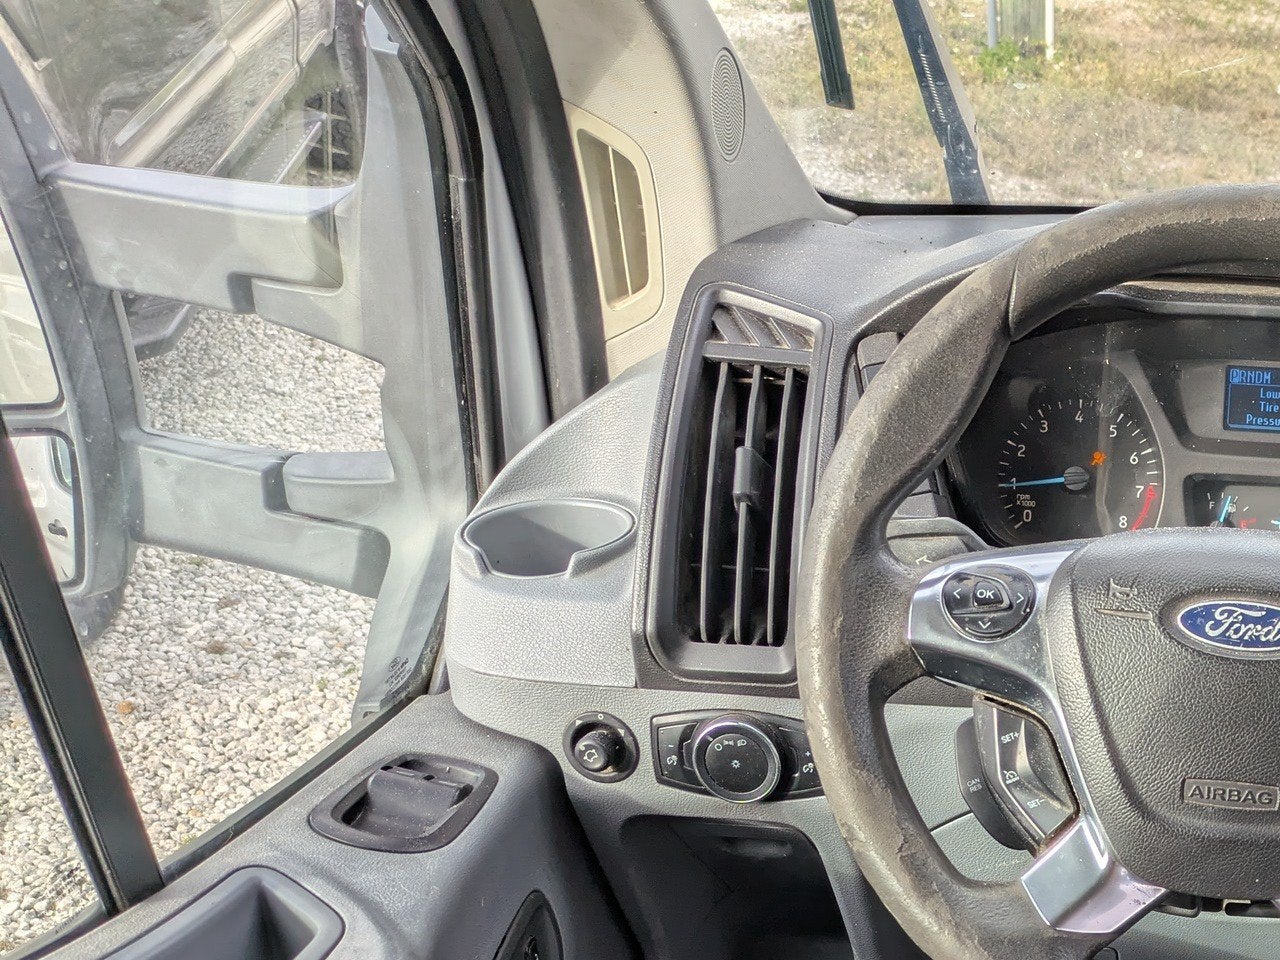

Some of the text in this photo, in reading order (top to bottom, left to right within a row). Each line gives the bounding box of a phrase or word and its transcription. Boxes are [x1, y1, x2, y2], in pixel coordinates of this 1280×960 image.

[1259, 401, 1280, 413] Tire
[1075, 410, 1083, 423] 4
[1040, 420, 1048, 433] 3
[1109, 425, 1117, 438] 5
[1017, 444, 1026, 457] 2
[1130, 452, 1139, 464] 6
[1135, 486, 1144, 498] 7
[1209, 501, 1216, 510] F
[1023, 509, 1032, 522] 0
[1119, 516, 1128, 528] 8
[976, 588, 994, 600] OK
[966, 778, 980, 788] CAN
[1188, 785, 1274, 806] AIRBAG
